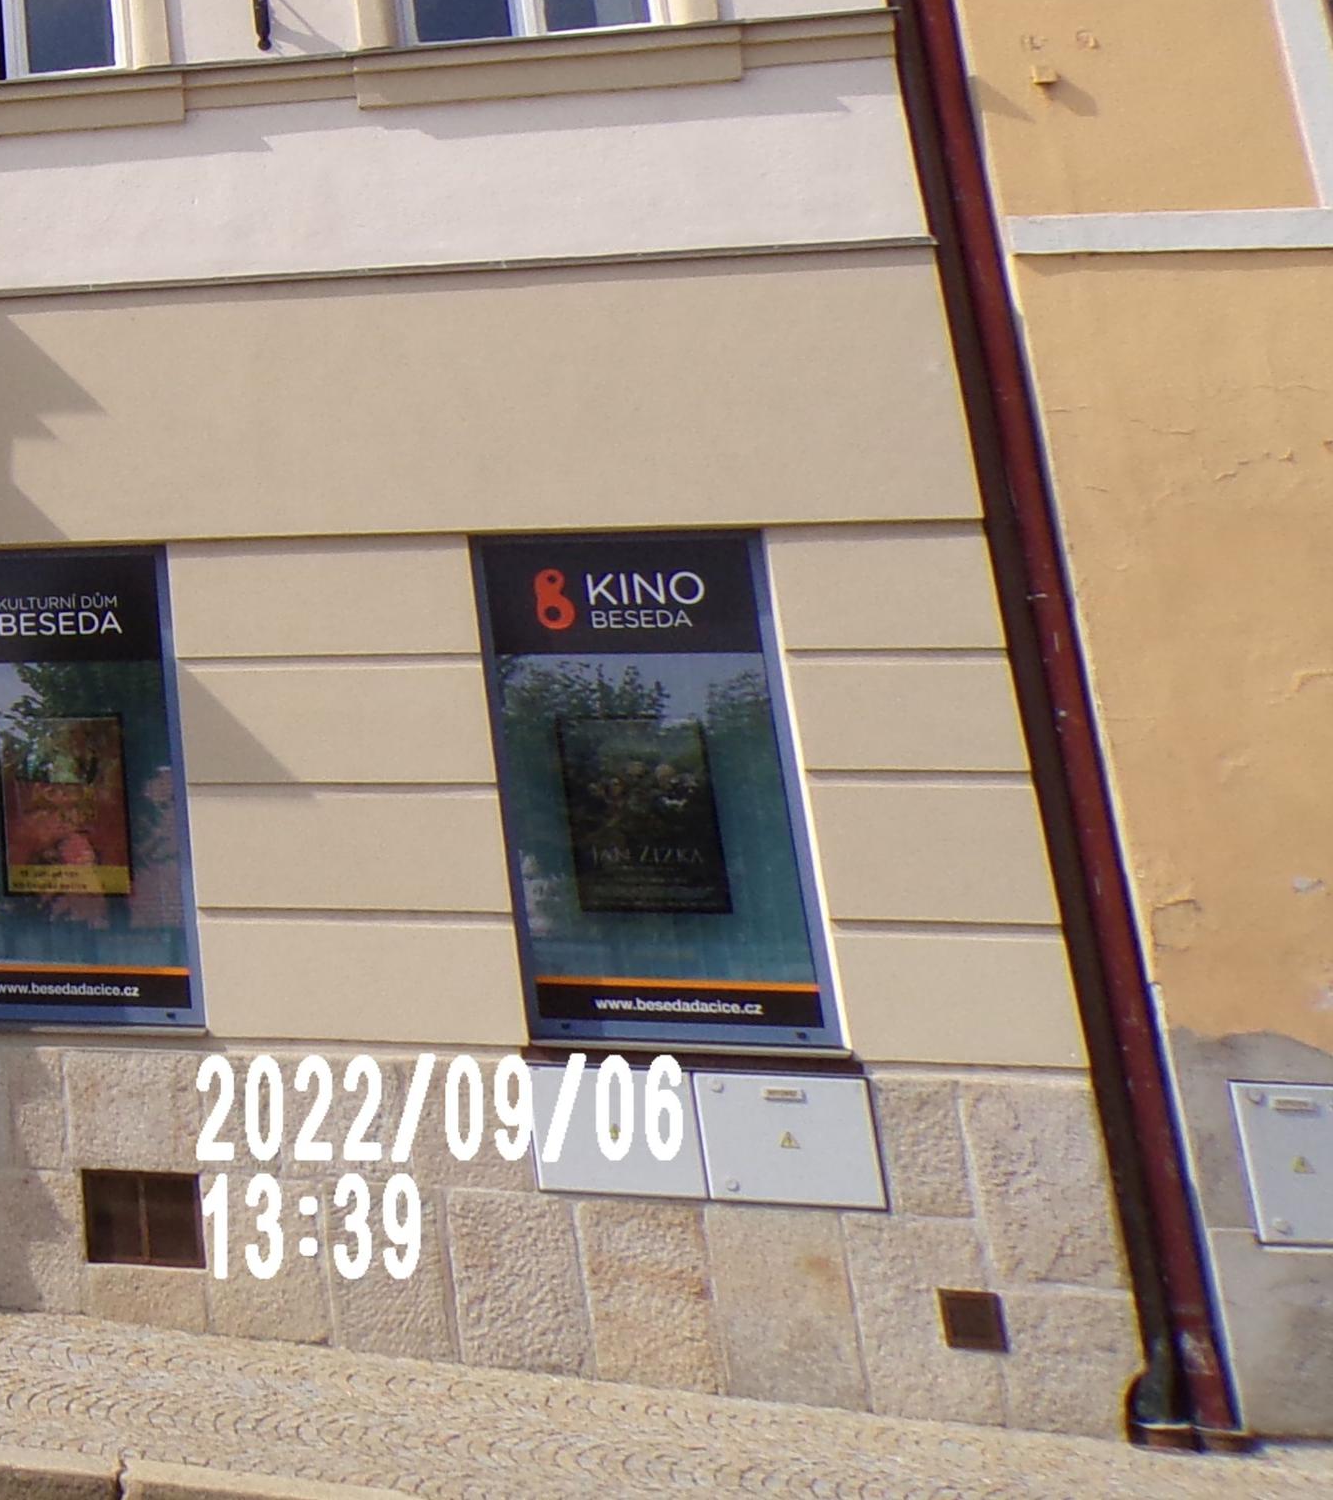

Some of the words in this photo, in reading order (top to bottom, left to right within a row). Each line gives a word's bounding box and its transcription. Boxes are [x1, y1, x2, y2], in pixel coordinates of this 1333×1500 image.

[585, 571, 705, 606] KINO
[80, 591, 118, 610] DŮM
[590, 609, 693, 629] BESEDA
[594, 997, 765, 1015] www.besedadacice.cz
